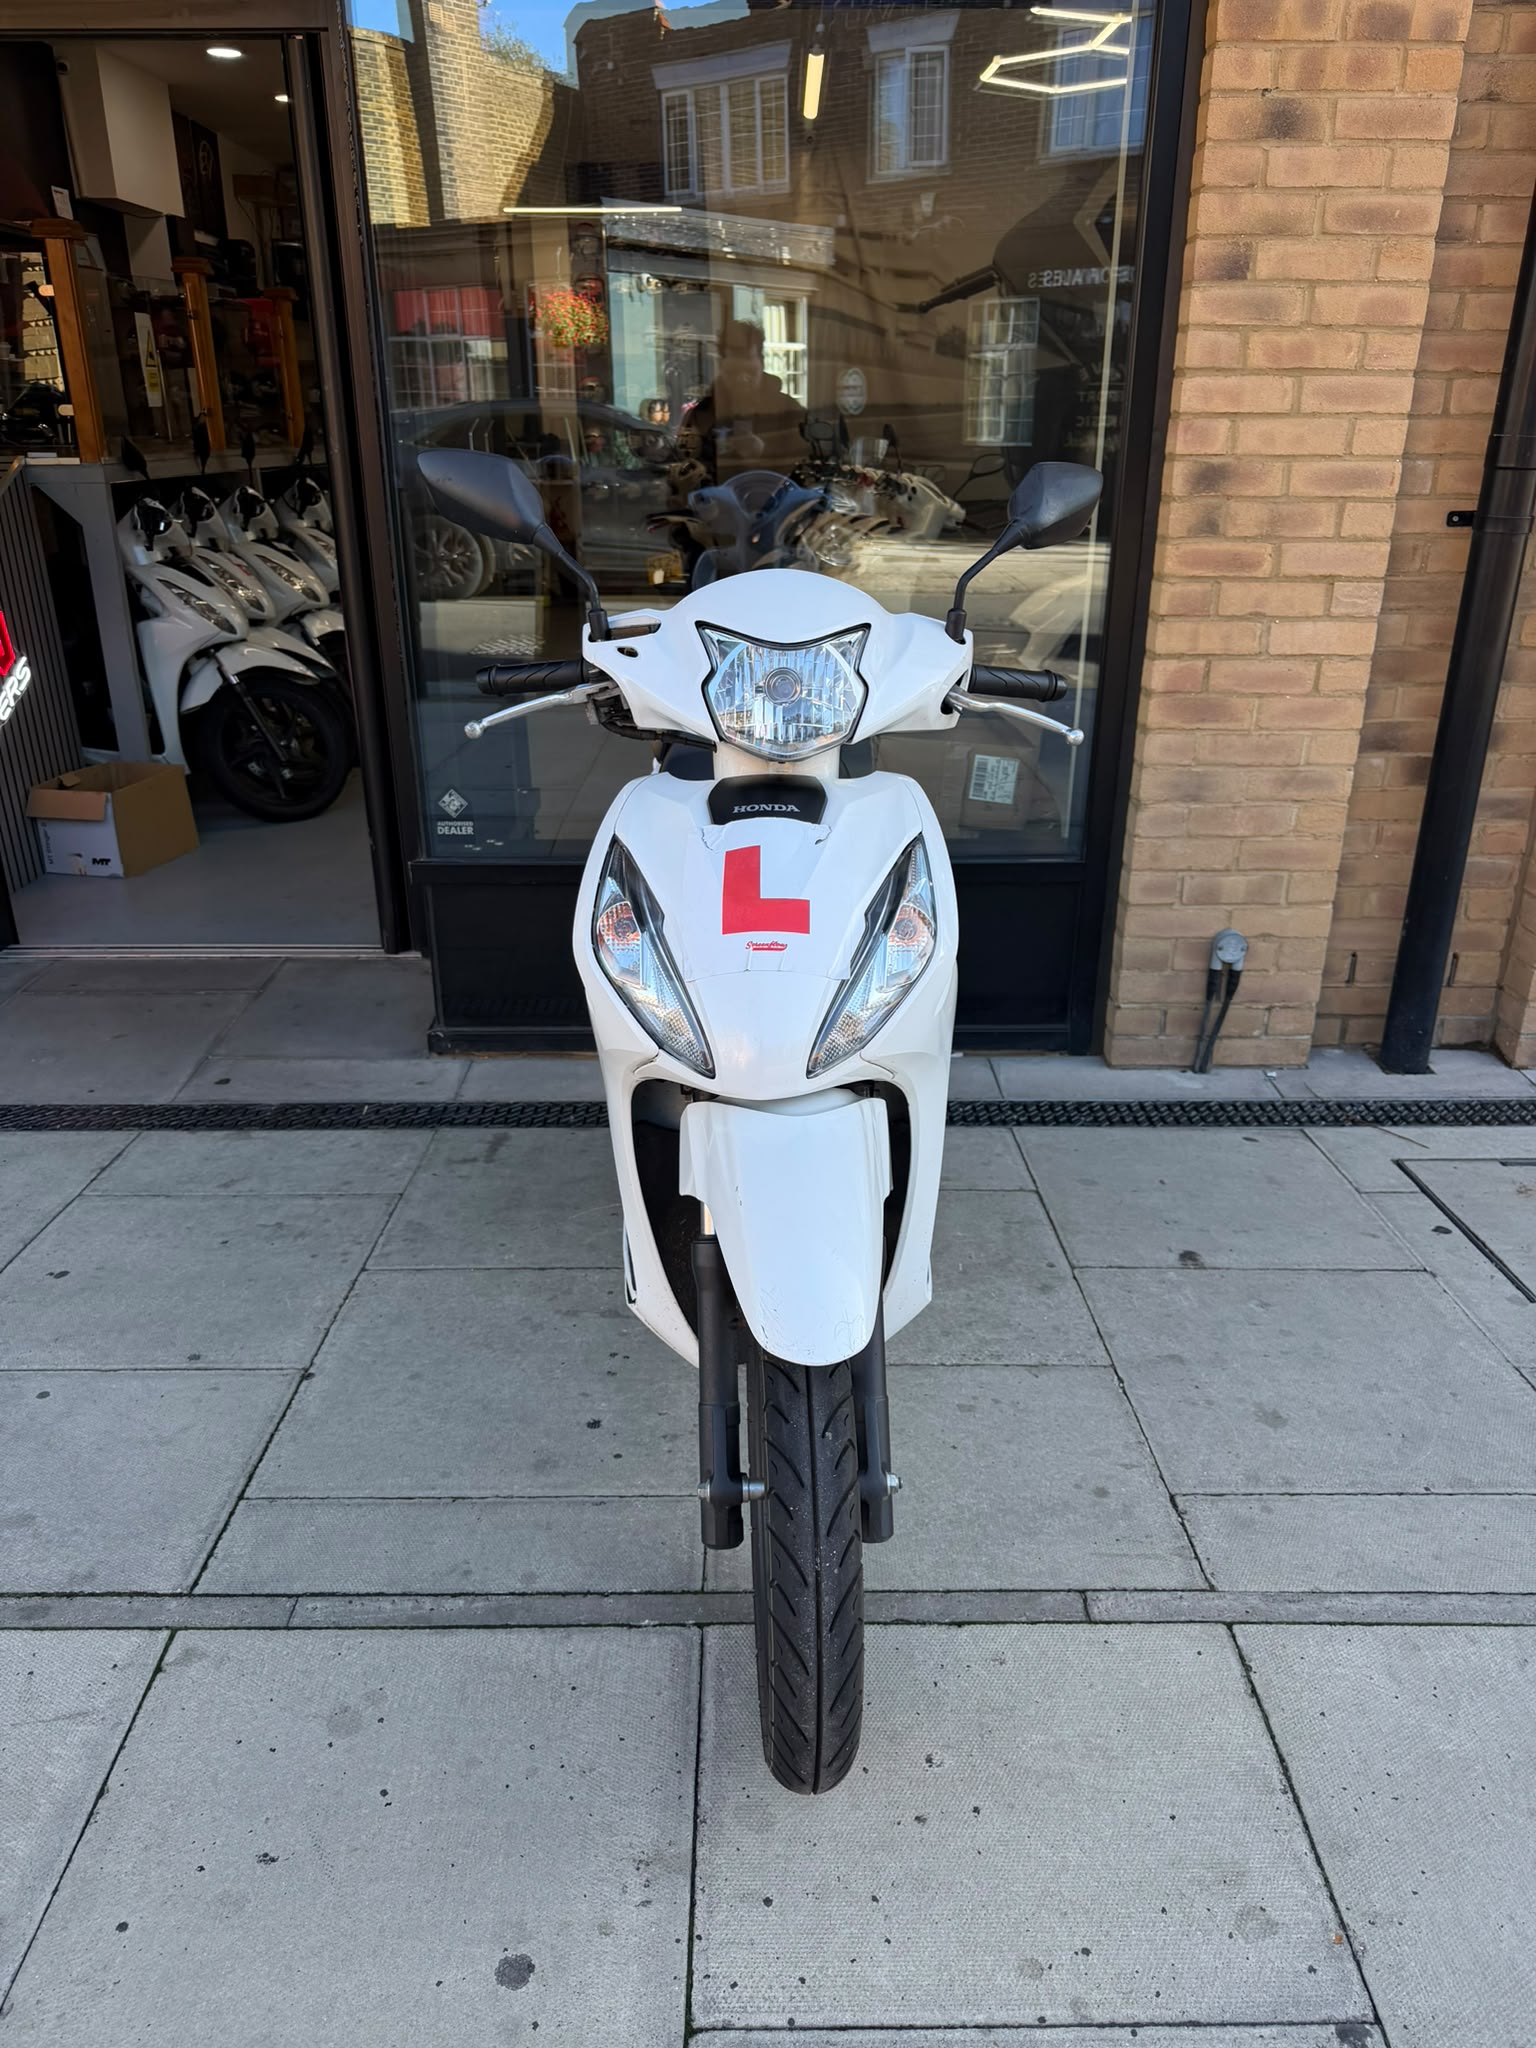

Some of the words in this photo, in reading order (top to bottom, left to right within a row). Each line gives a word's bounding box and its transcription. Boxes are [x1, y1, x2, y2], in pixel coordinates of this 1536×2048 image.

[733, 804, 800, 813] HONDA
[437, 827, 474, 835] DEALER
[92, 858, 111, 866] MT
[722, 845, 810, 934] L
